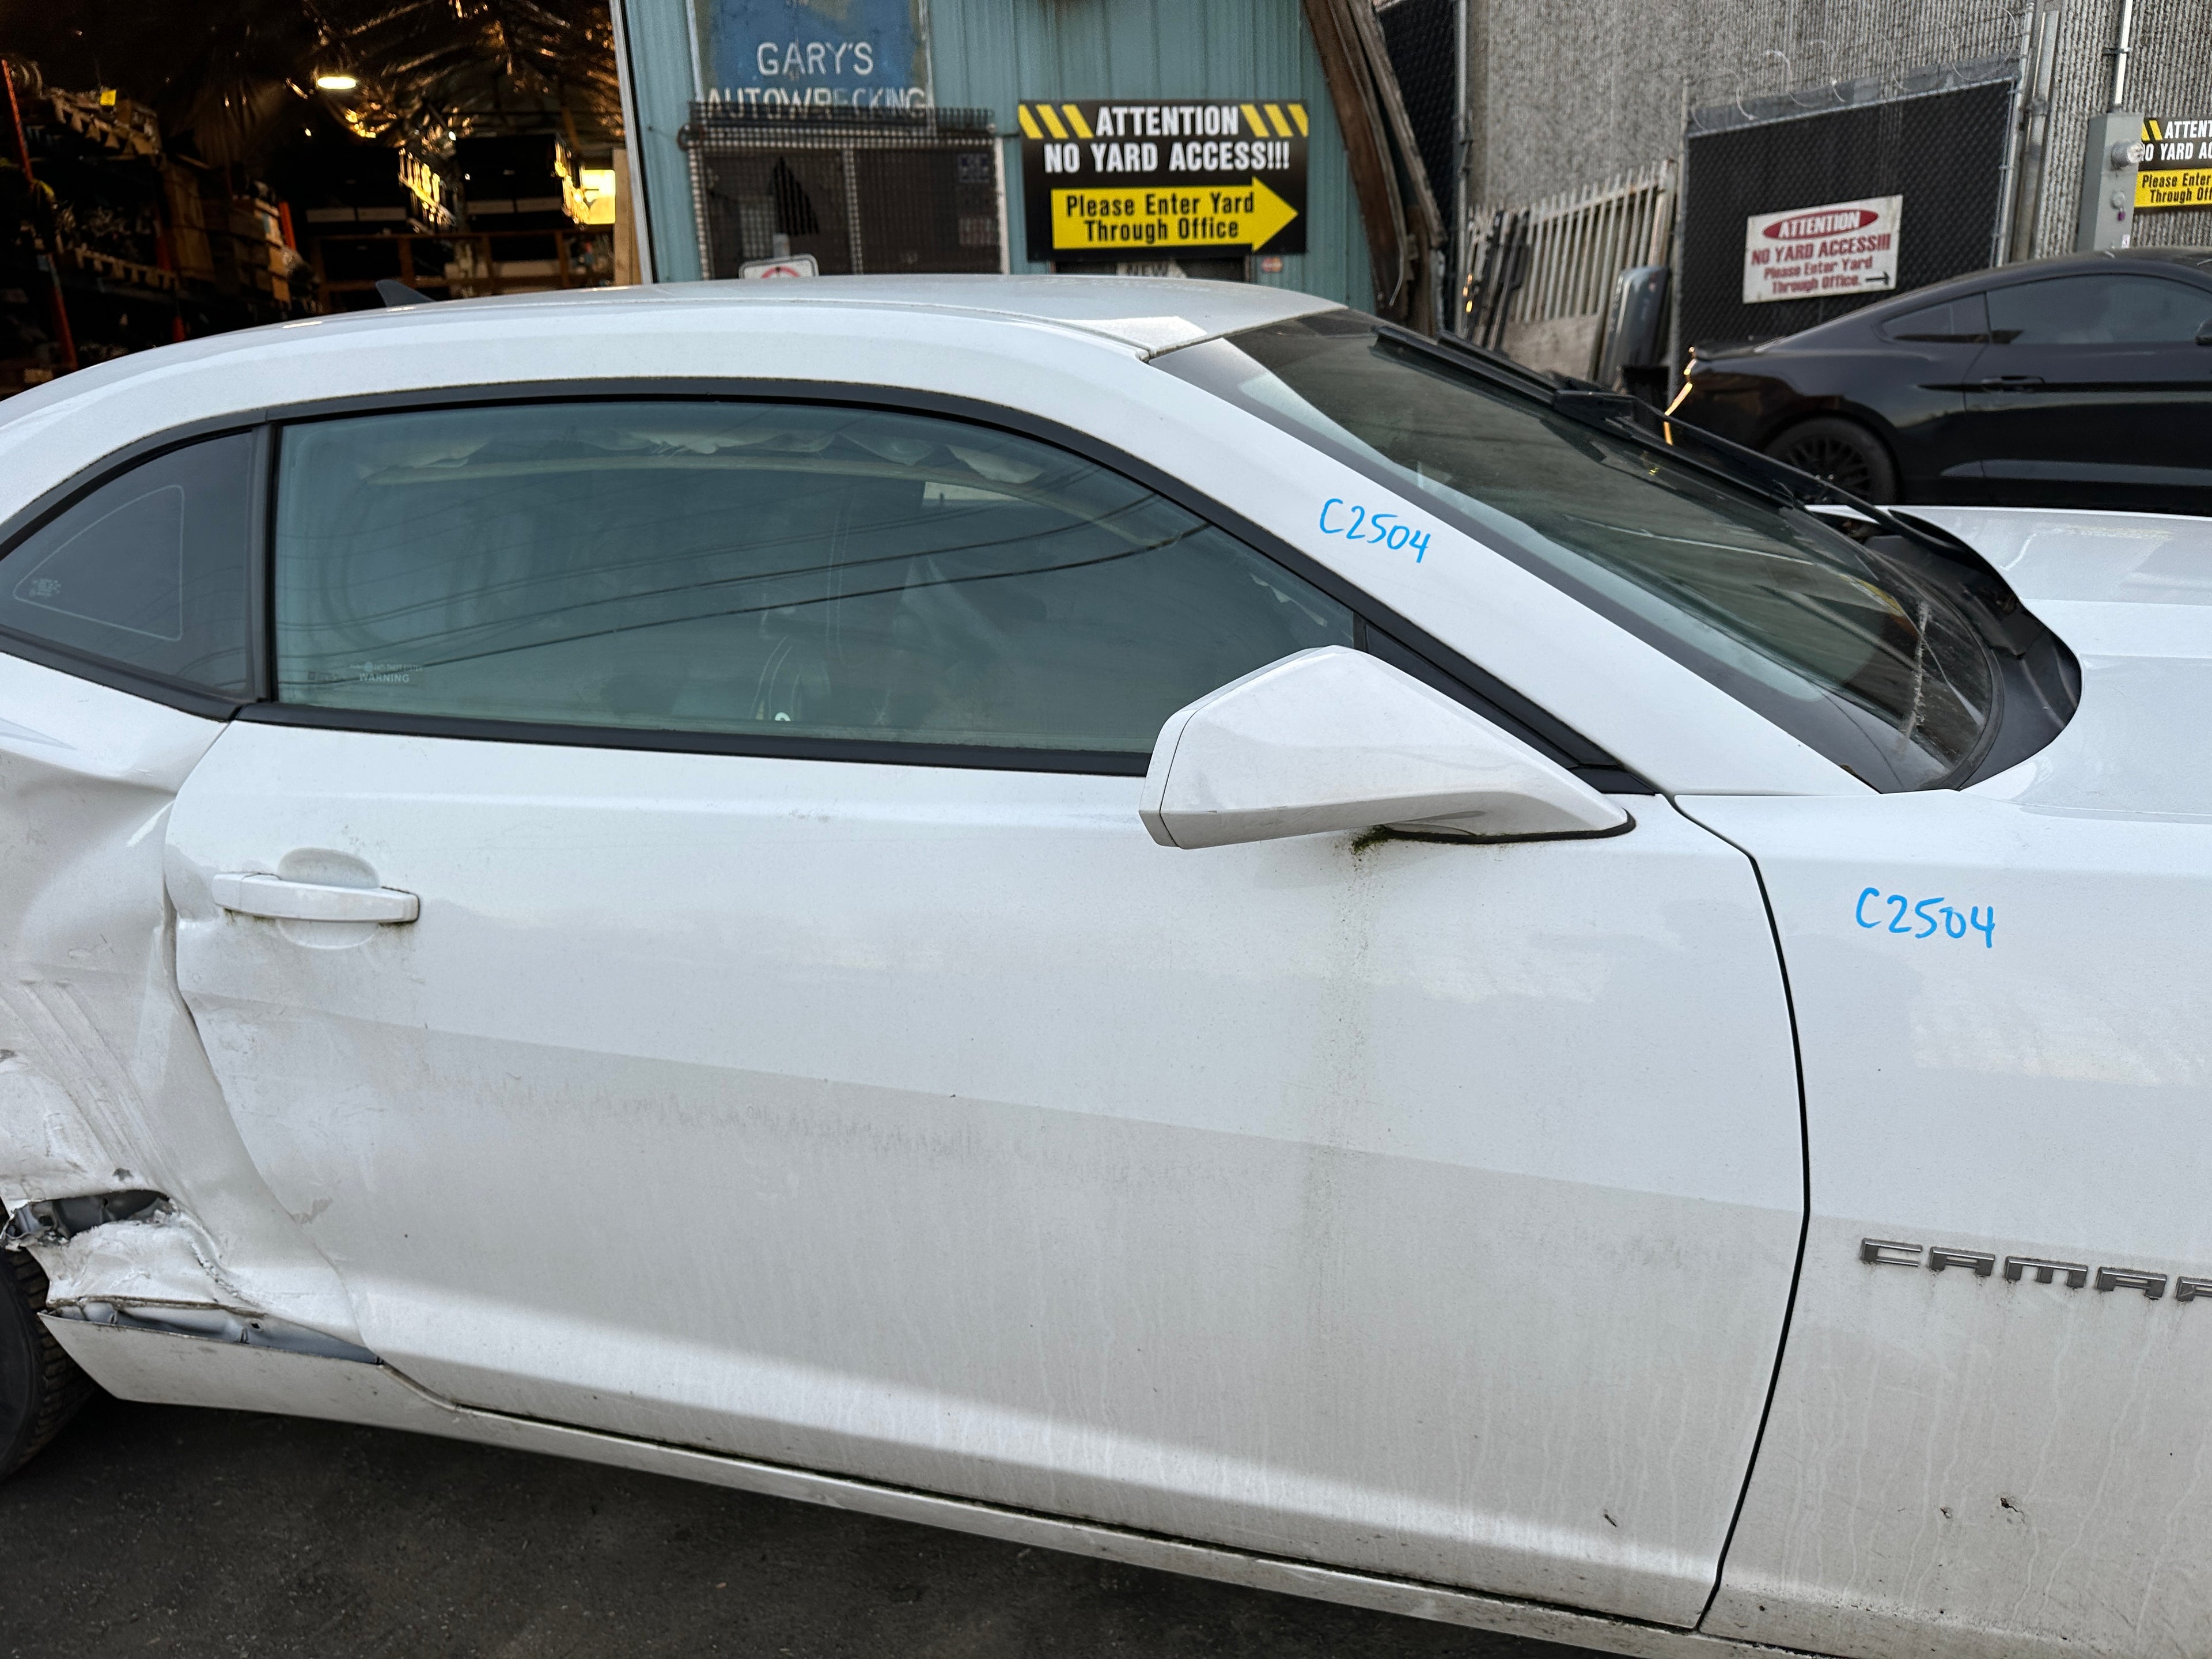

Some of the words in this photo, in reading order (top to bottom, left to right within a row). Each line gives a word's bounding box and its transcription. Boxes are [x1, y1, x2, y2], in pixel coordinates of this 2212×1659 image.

[756, 41, 874, 76] GARY'S
[1096, 105, 1239, 137] ATTENTION
[1044, 143, 1080, 173] NO
[1090, 142, 1158, 172] YARD
[1168, 141, 1290, 171] ACCESS!!!
[2142, 143, 2154, 161] O
[2160, 142, 2194, 161] YARD
[2142, 174, 2177, 188] Please
[2182, 172, 2211, 187] Enter
[1066, 194, 1135, 218] Please
[1145, 193, 1200, 217] Enter
[1211, 191, 1255, 214] Yard
[2150, 187, 2192, 203] Through
[1084, 219, 1168, 244] Through
[1177, 218, 1239, 240] Office
[1777, 210, 1861, 238] ATTENTION
[1751, 249, 1770, 266] NO
[1775, 243, 1814, 262] YARD
[1817, 233, 1891, 257] ACCESS!!!
[1764, 266, 1801, 281] Please
[1804, 261, 1838, 275] Enter
[1842, 255, 1873, 271] Yard
[1772, 278, 1819, 294] Through
[1319, 498, 1431, 563] C2504
[359, 673, 410, 683] WARNING
[1855, 887, 1995, 949] C2504
